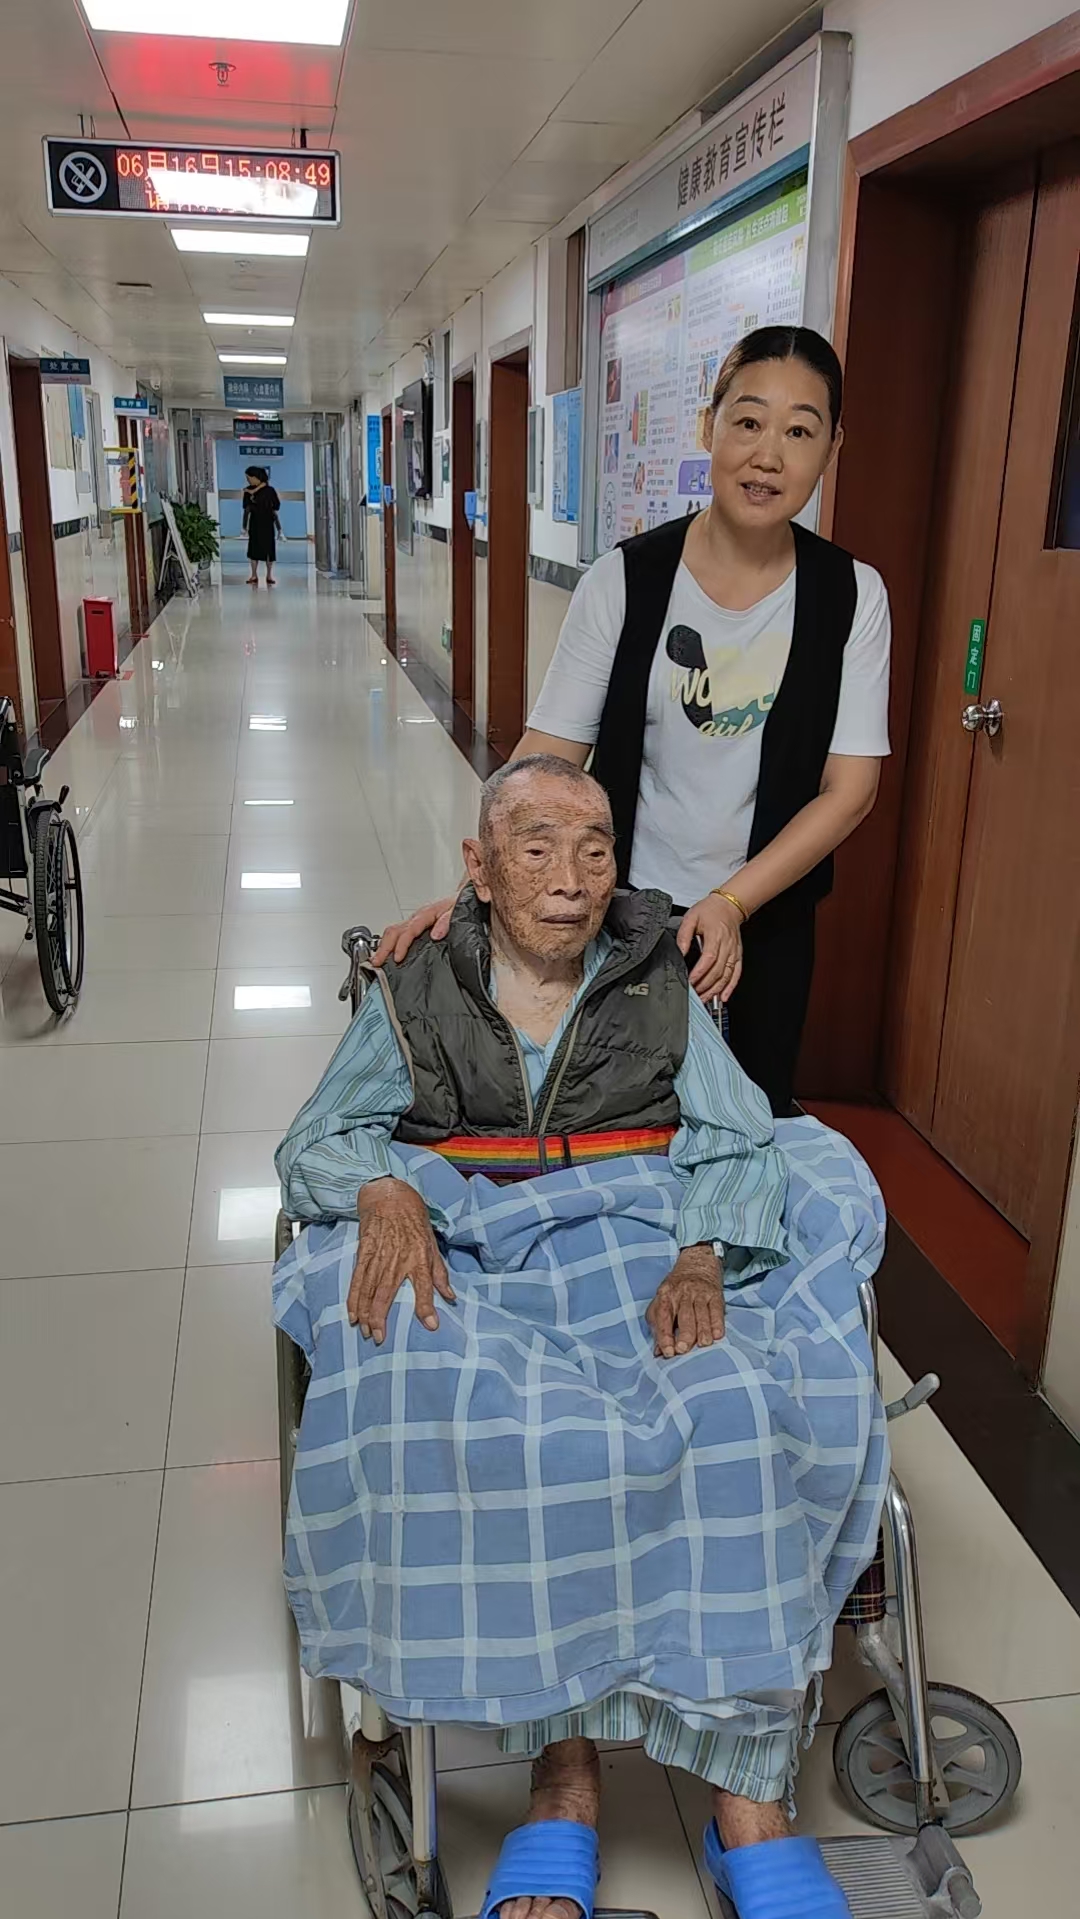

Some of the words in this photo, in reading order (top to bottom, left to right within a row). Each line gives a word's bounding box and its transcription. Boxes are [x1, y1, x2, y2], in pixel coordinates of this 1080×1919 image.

[677, 91, 786, 211] 健康教育宣传栏
